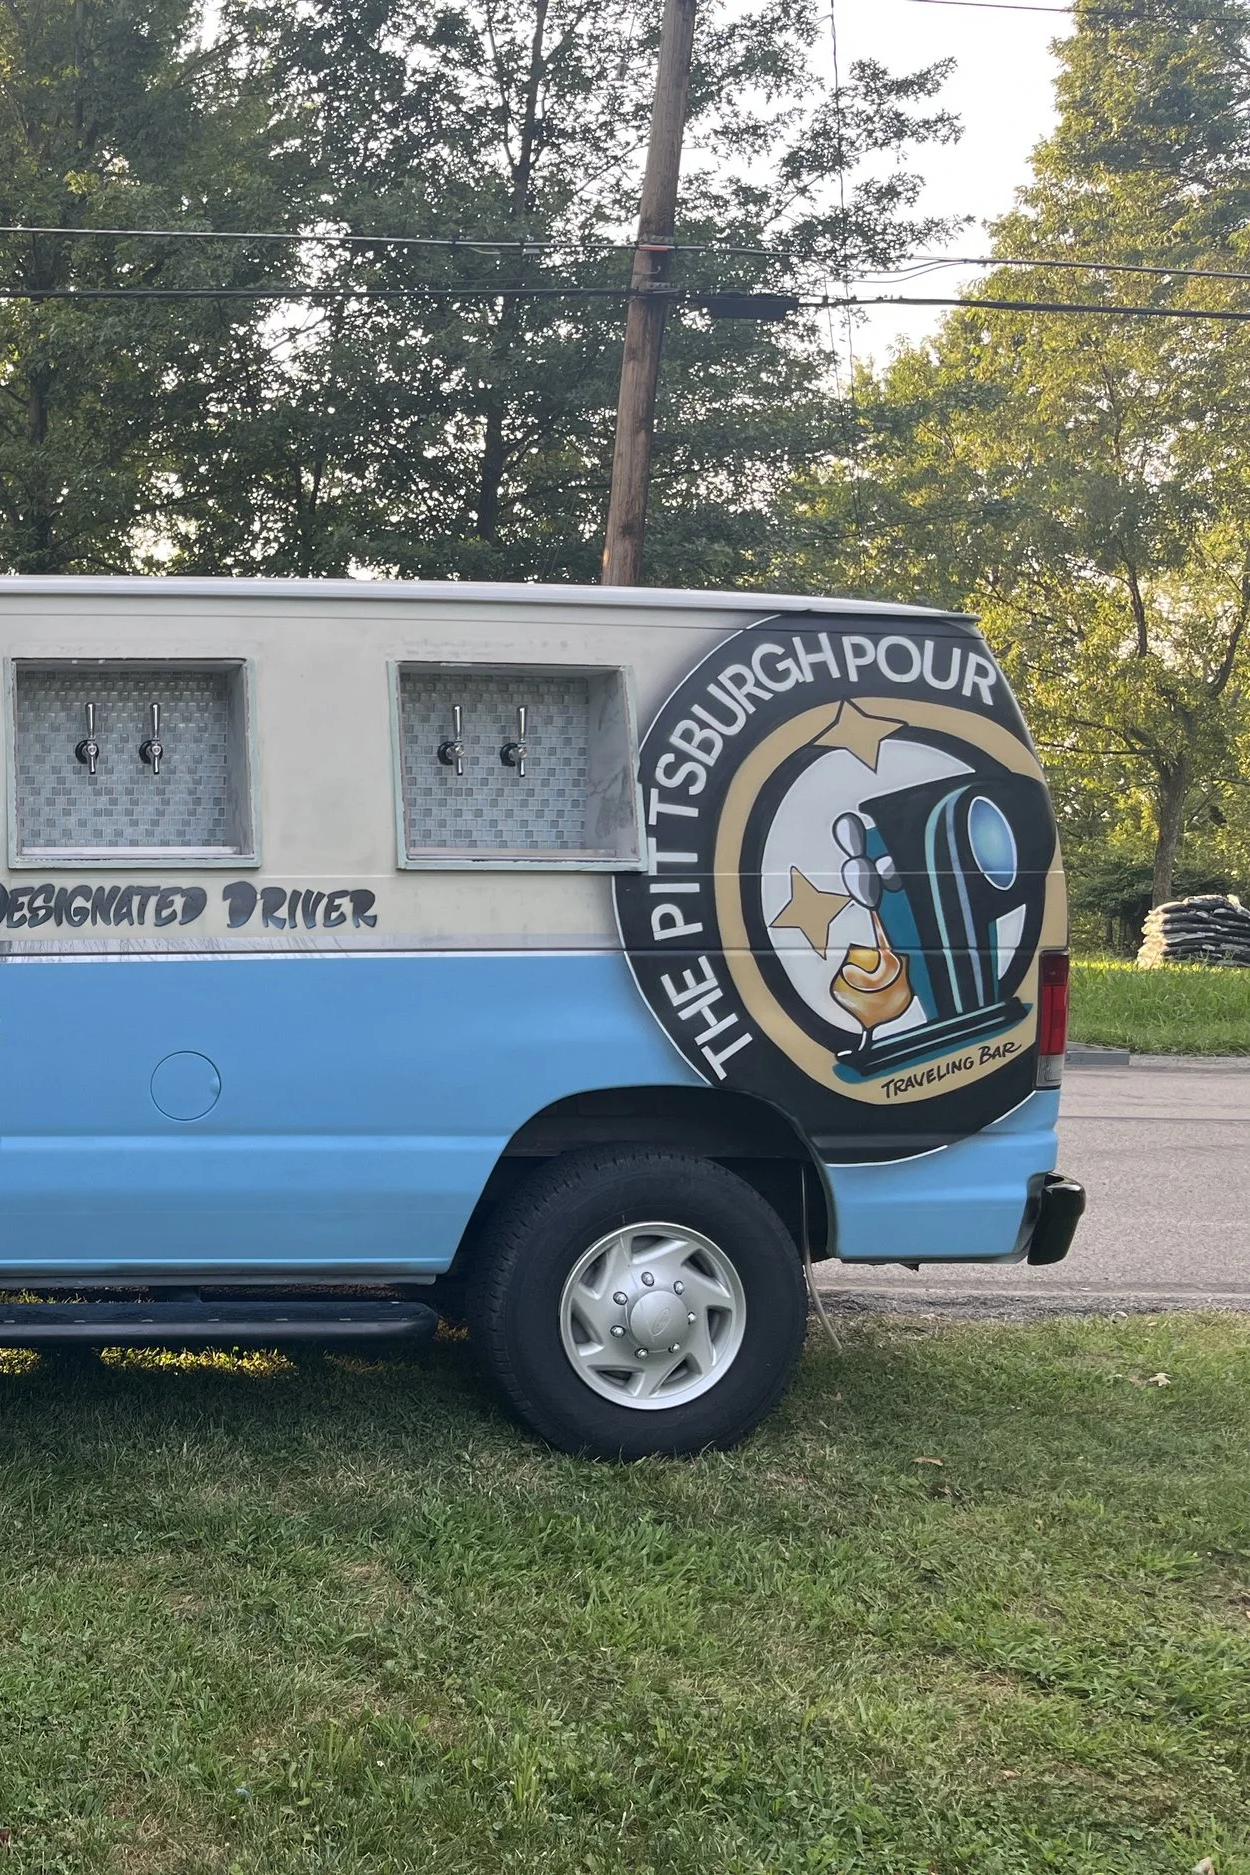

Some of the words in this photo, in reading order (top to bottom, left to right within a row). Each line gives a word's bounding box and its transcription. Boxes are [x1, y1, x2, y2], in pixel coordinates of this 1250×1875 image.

[841, 636, 997, 706] POUR
[648, 632, 841, 940] PITTSBURGH
[222, 881, 378, 930] DRIVER
[660, 956, 753, 1081] THE
[881, 1057, 974, 1098] TRAVELING
[978, 1042, 1022, 1065] BAR
